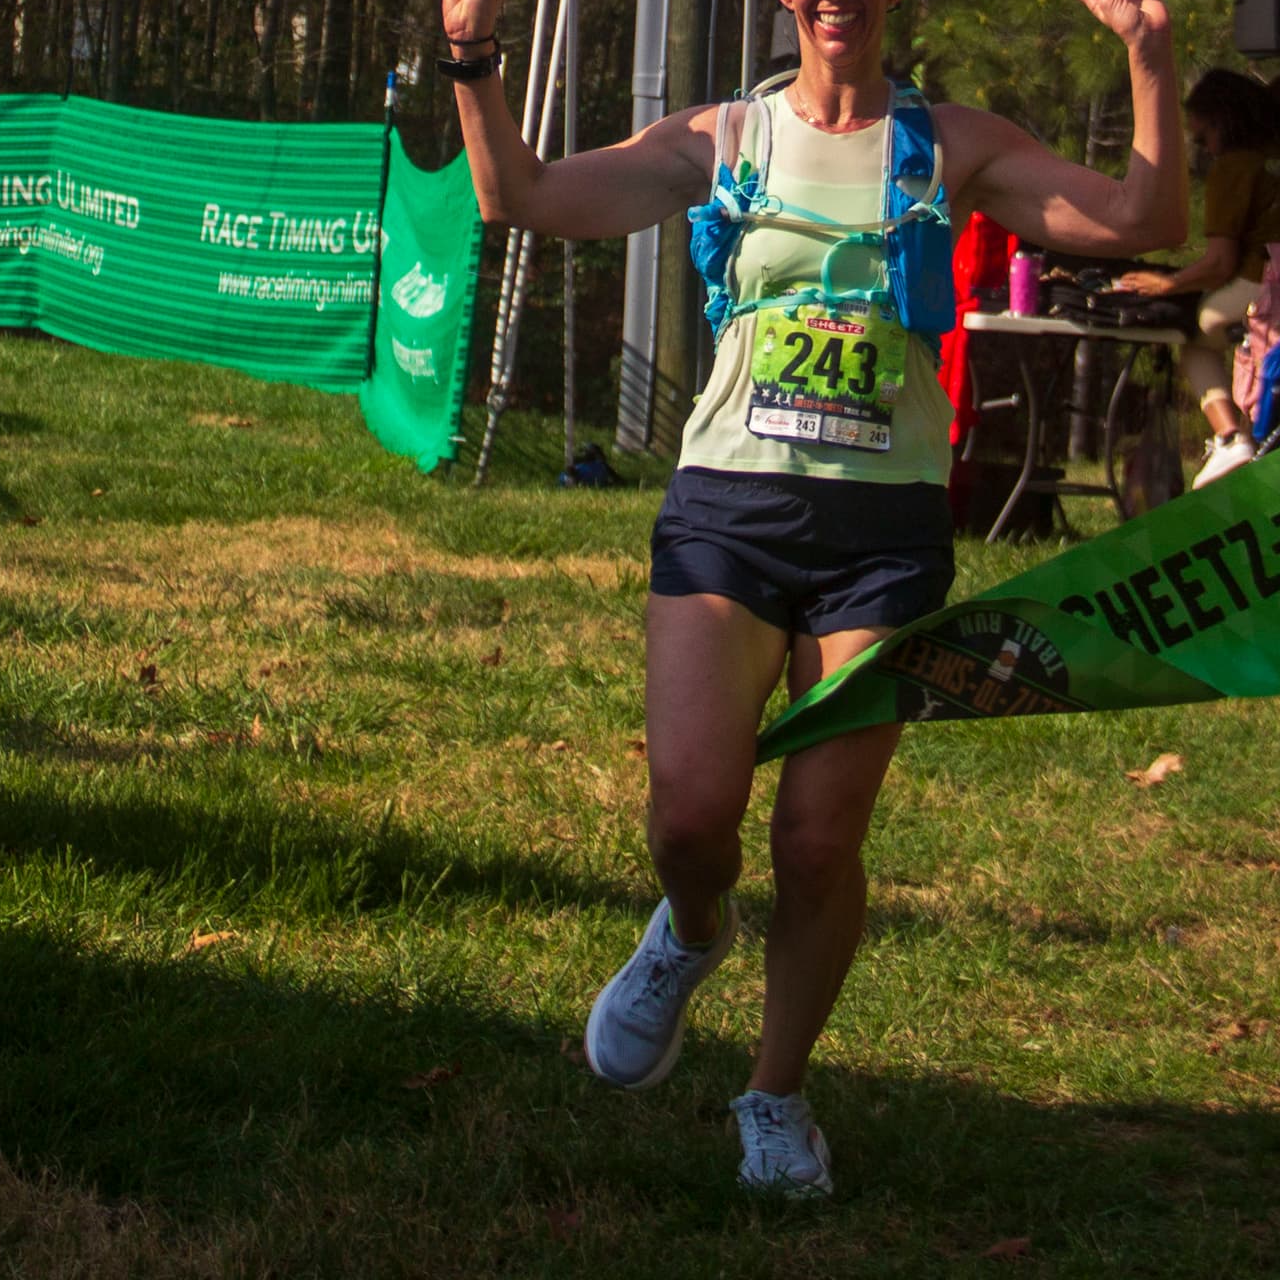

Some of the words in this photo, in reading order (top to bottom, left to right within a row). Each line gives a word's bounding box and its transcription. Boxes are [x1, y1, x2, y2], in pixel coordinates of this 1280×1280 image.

[200, 203, 263, 250] RACE
[268, 211, 348, 254] TIMING
[808, 319, 864, 334] SHEETZ
[779, 331, 879, 396] 243
[796, 419, 817, 433] 243
[869, 430, 888, 445] 243
[959, 612, 1002, 637] RUN
[1014, 617, 1067, 680] TRAIL
